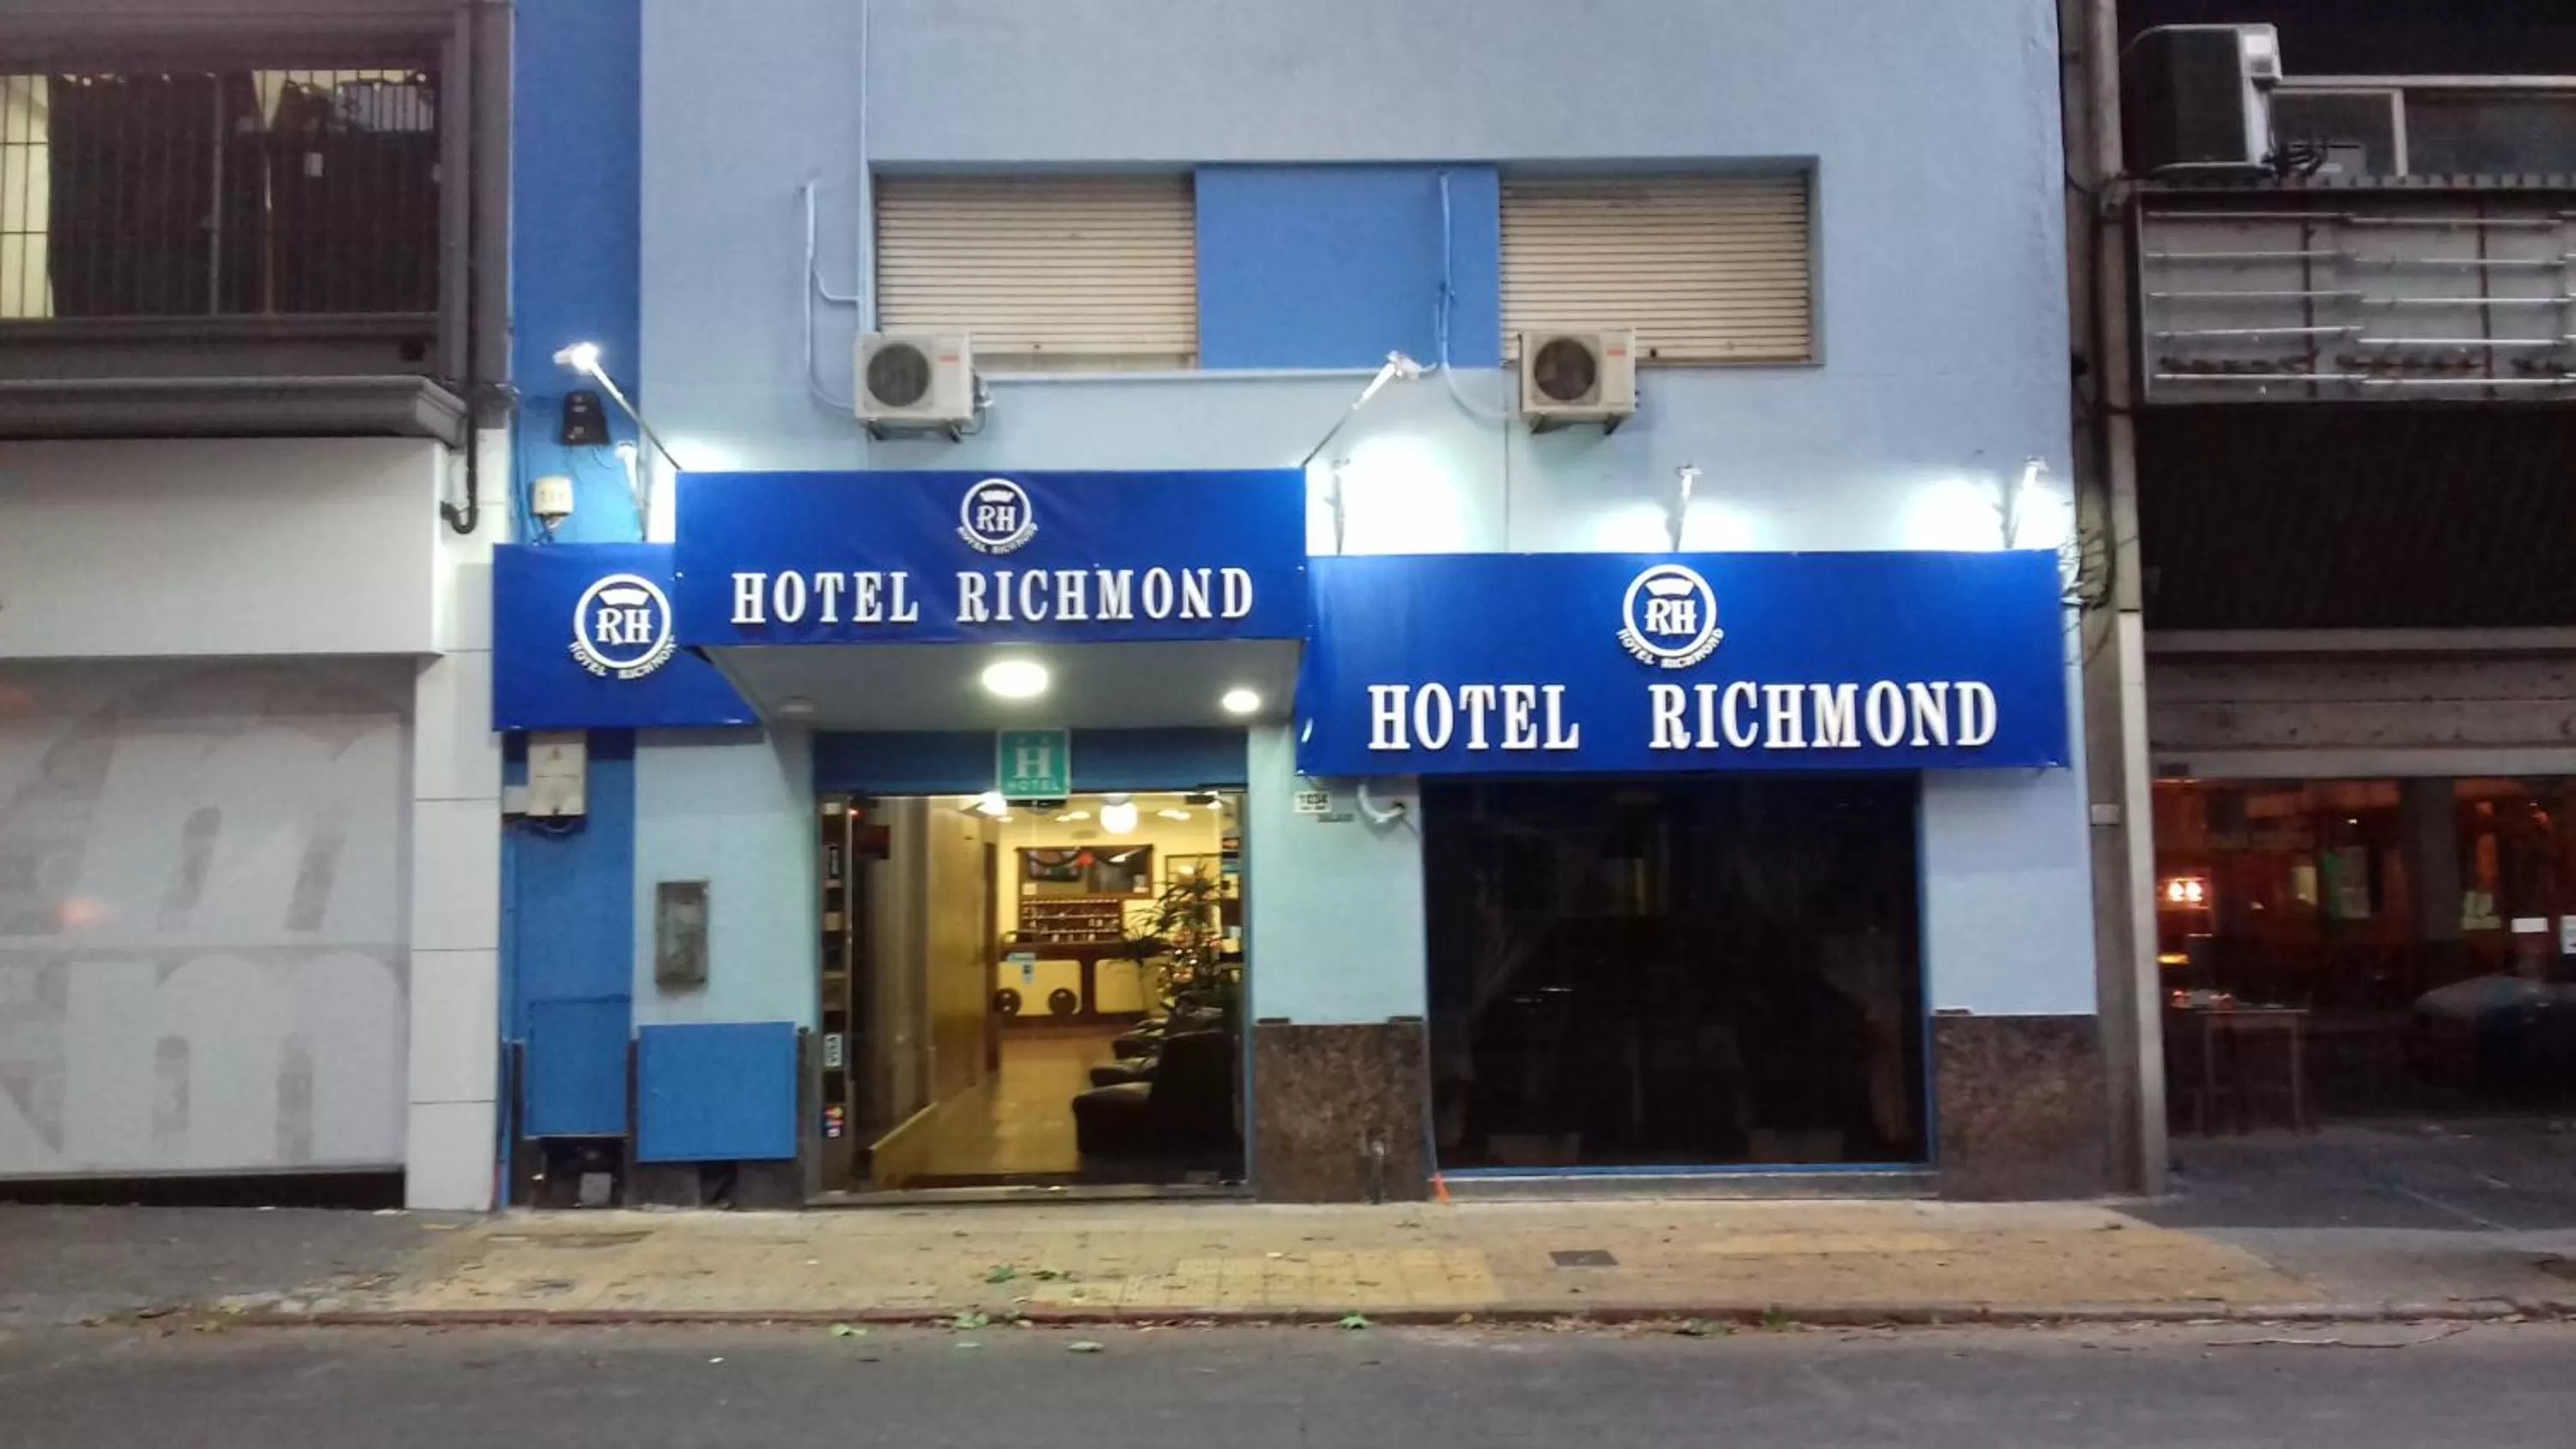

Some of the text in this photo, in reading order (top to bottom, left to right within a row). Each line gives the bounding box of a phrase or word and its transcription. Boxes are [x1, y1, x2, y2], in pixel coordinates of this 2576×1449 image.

[975, 505, 1017, 532] RH
[731, 567, 1254, 624] HOTEL RICHMOND
[595, 607, 653, 646] RH
[1644, 597, 1698, 635] RH
[568, 640, 607, 676] HOTEL
[1616, 627, 1725, 670] HOTEL RICHMOND
[1368, 680, 1998, 750] HOTEL RICHMOND
[1013, 747, 1052, 779] H
[1006, 779, 1062, 791] HOTEL
